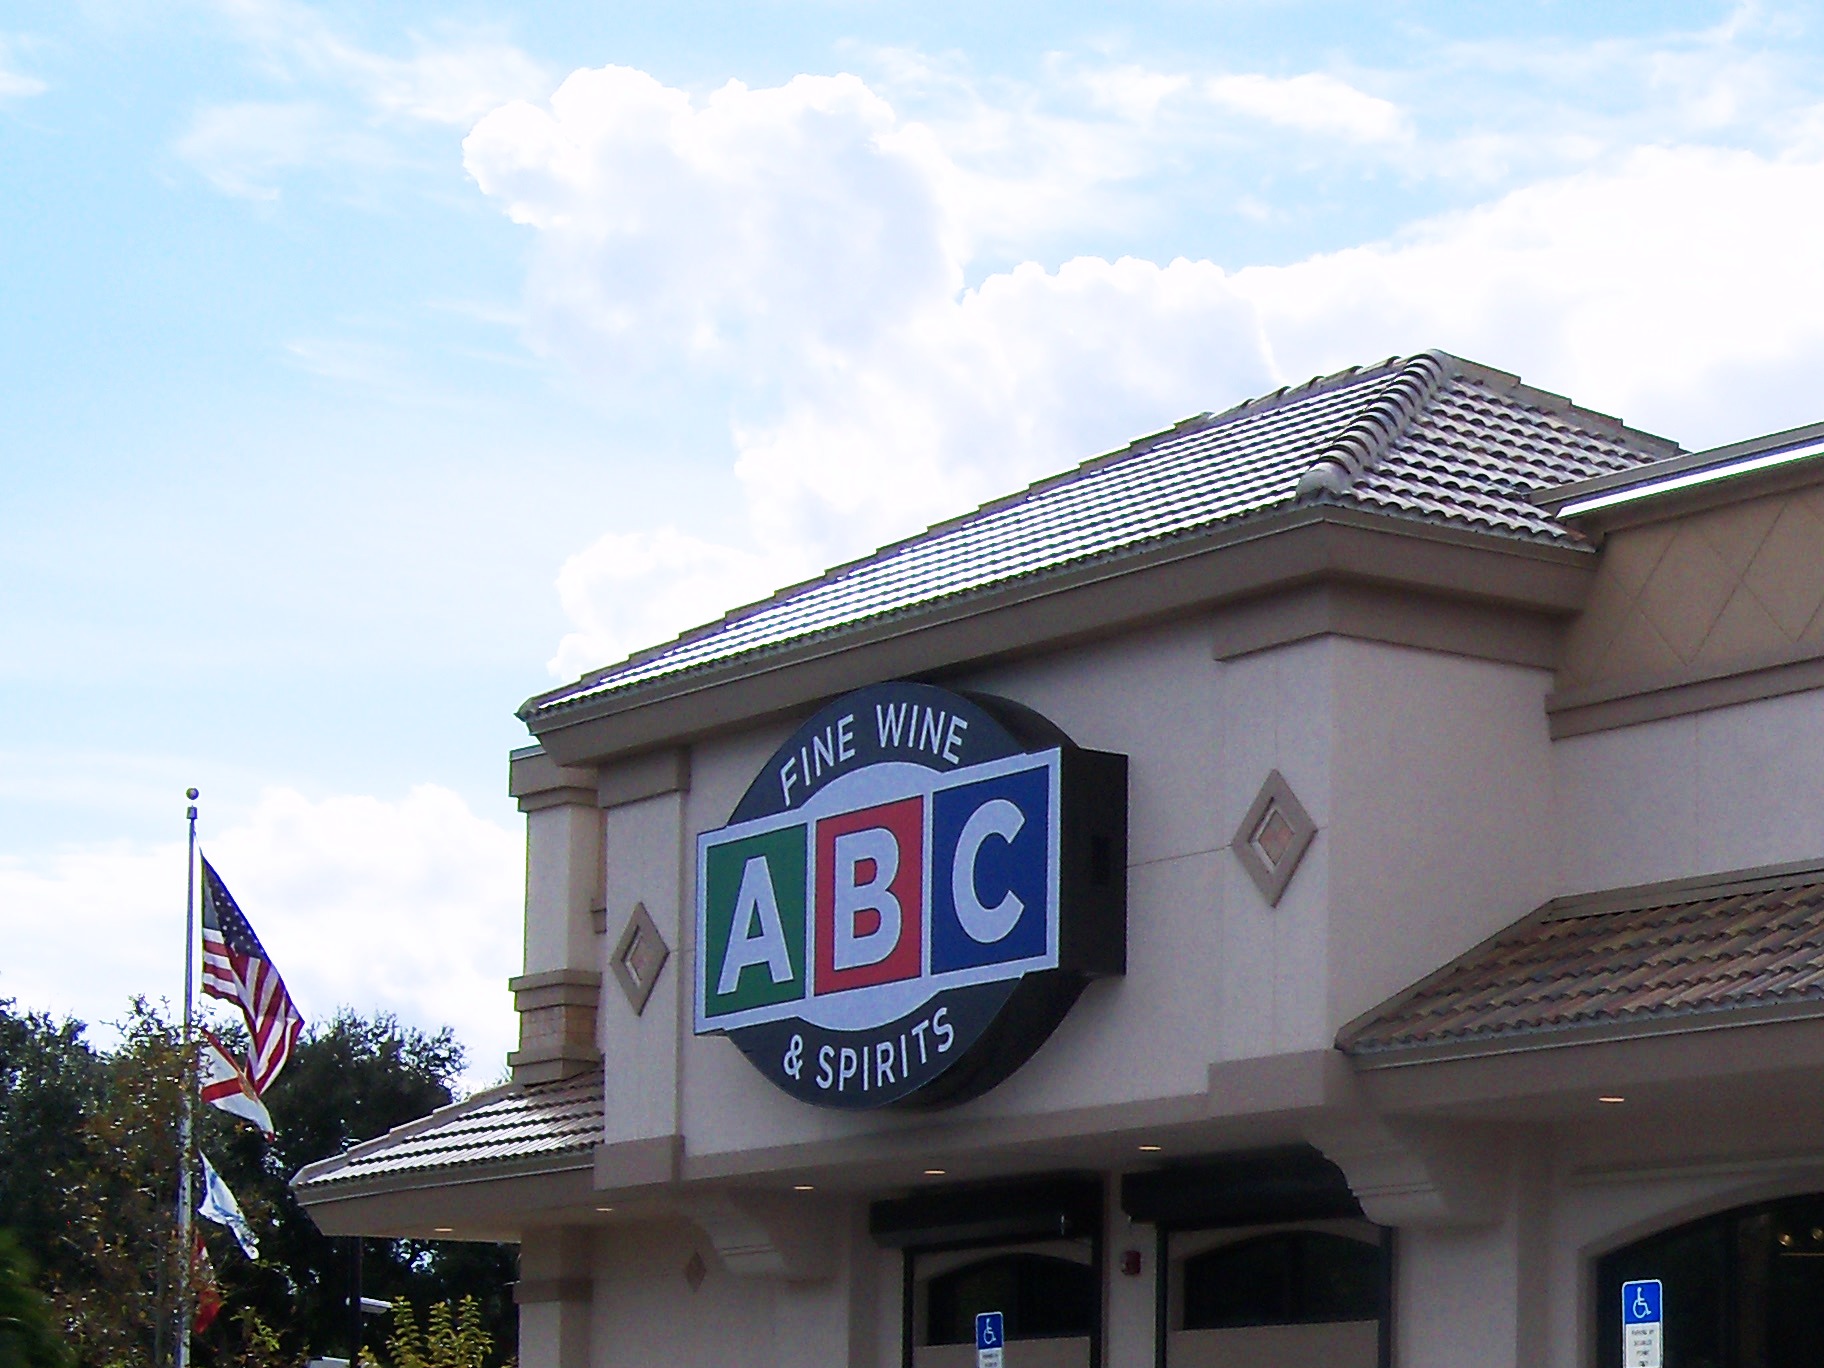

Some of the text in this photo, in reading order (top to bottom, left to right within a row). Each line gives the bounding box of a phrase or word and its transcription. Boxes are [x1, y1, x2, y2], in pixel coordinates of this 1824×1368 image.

[779, 702, 968, 807] FINE WINE
[716, 799, 1027, 995] ABC
[783, 1007, 955, 1092] & SPIRITS
